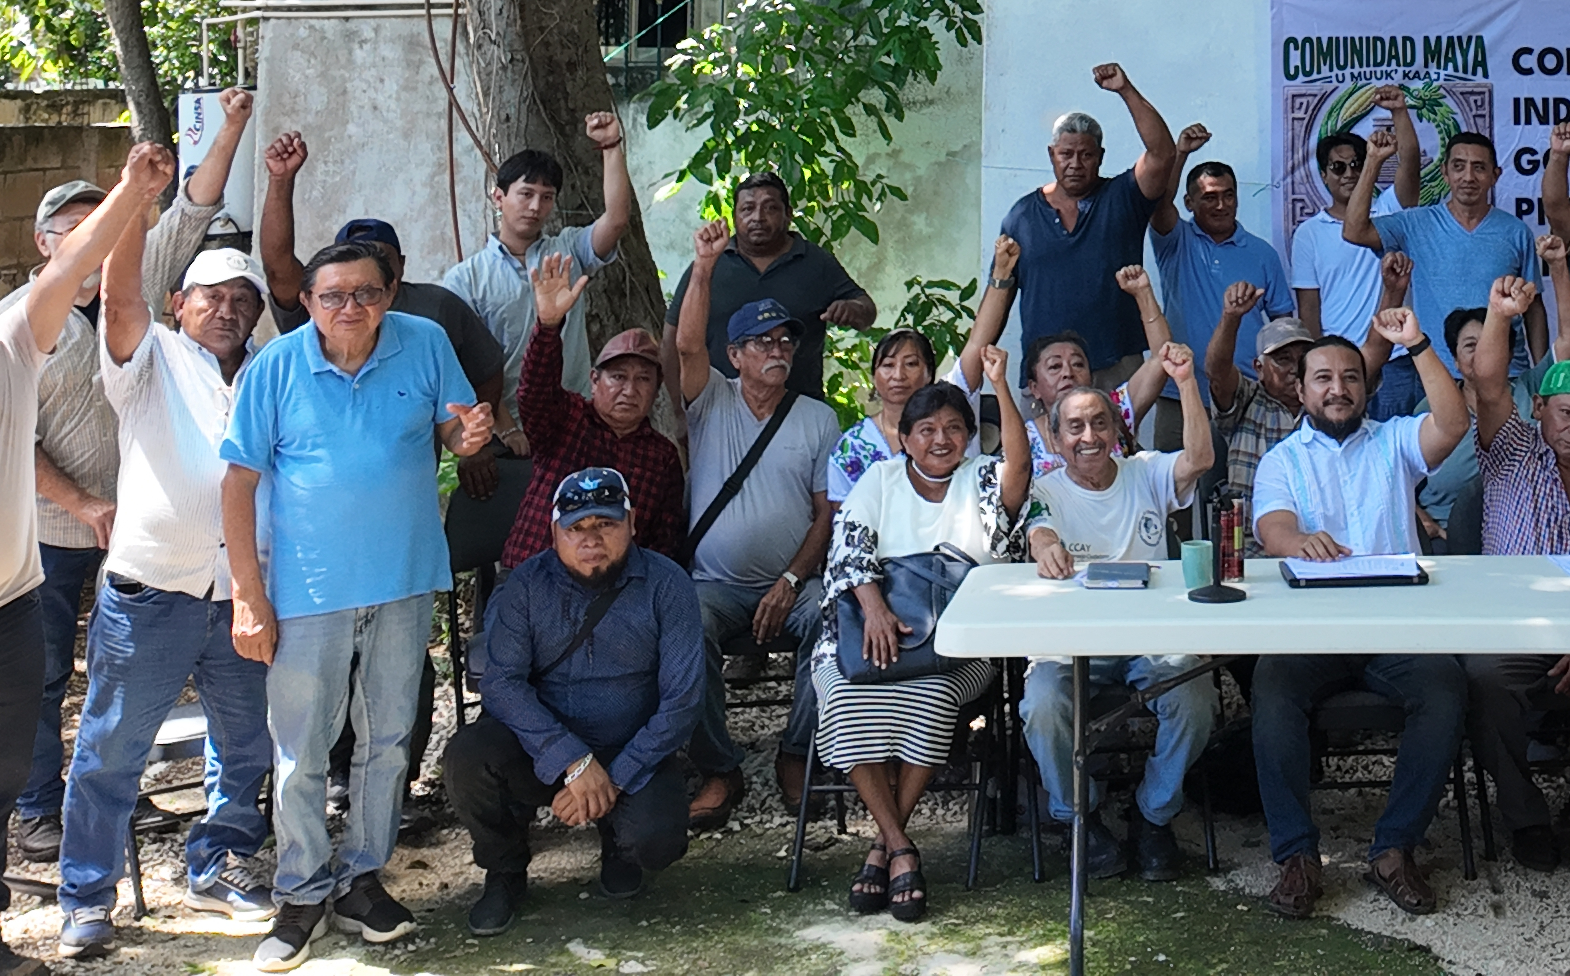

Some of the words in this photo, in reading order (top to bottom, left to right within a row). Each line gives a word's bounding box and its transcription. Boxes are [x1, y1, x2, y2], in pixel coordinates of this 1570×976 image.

[1283, 36, 1416, 81] COMUNIDAD
[1423, 35, 1490, 79] MAYA
[1335, 73, 1345, 84] U
[193, 97, 203, 132] CINSA
[1068, 542, 1091, 552] CCAY
